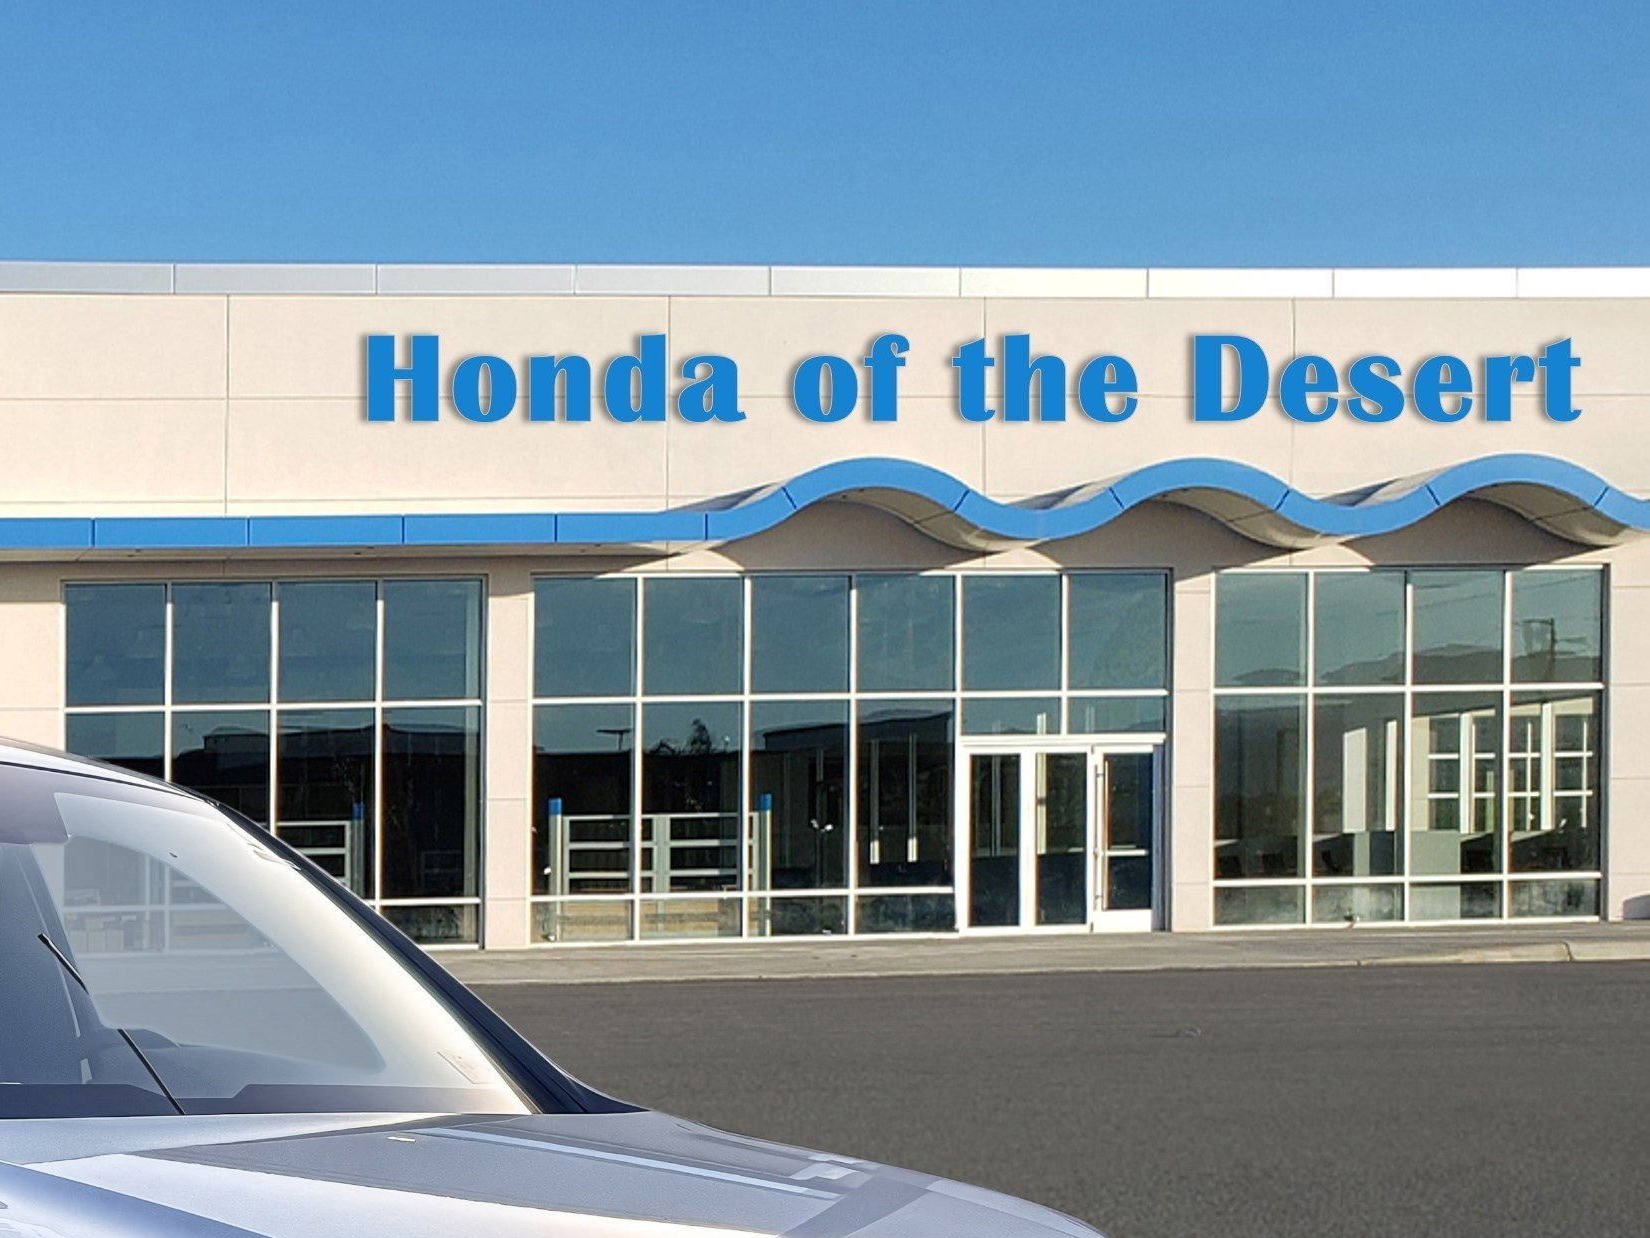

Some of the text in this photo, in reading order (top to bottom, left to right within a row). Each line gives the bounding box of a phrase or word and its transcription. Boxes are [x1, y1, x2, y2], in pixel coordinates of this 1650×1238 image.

[364, 332, 1583, 423] Honda of the Desert
